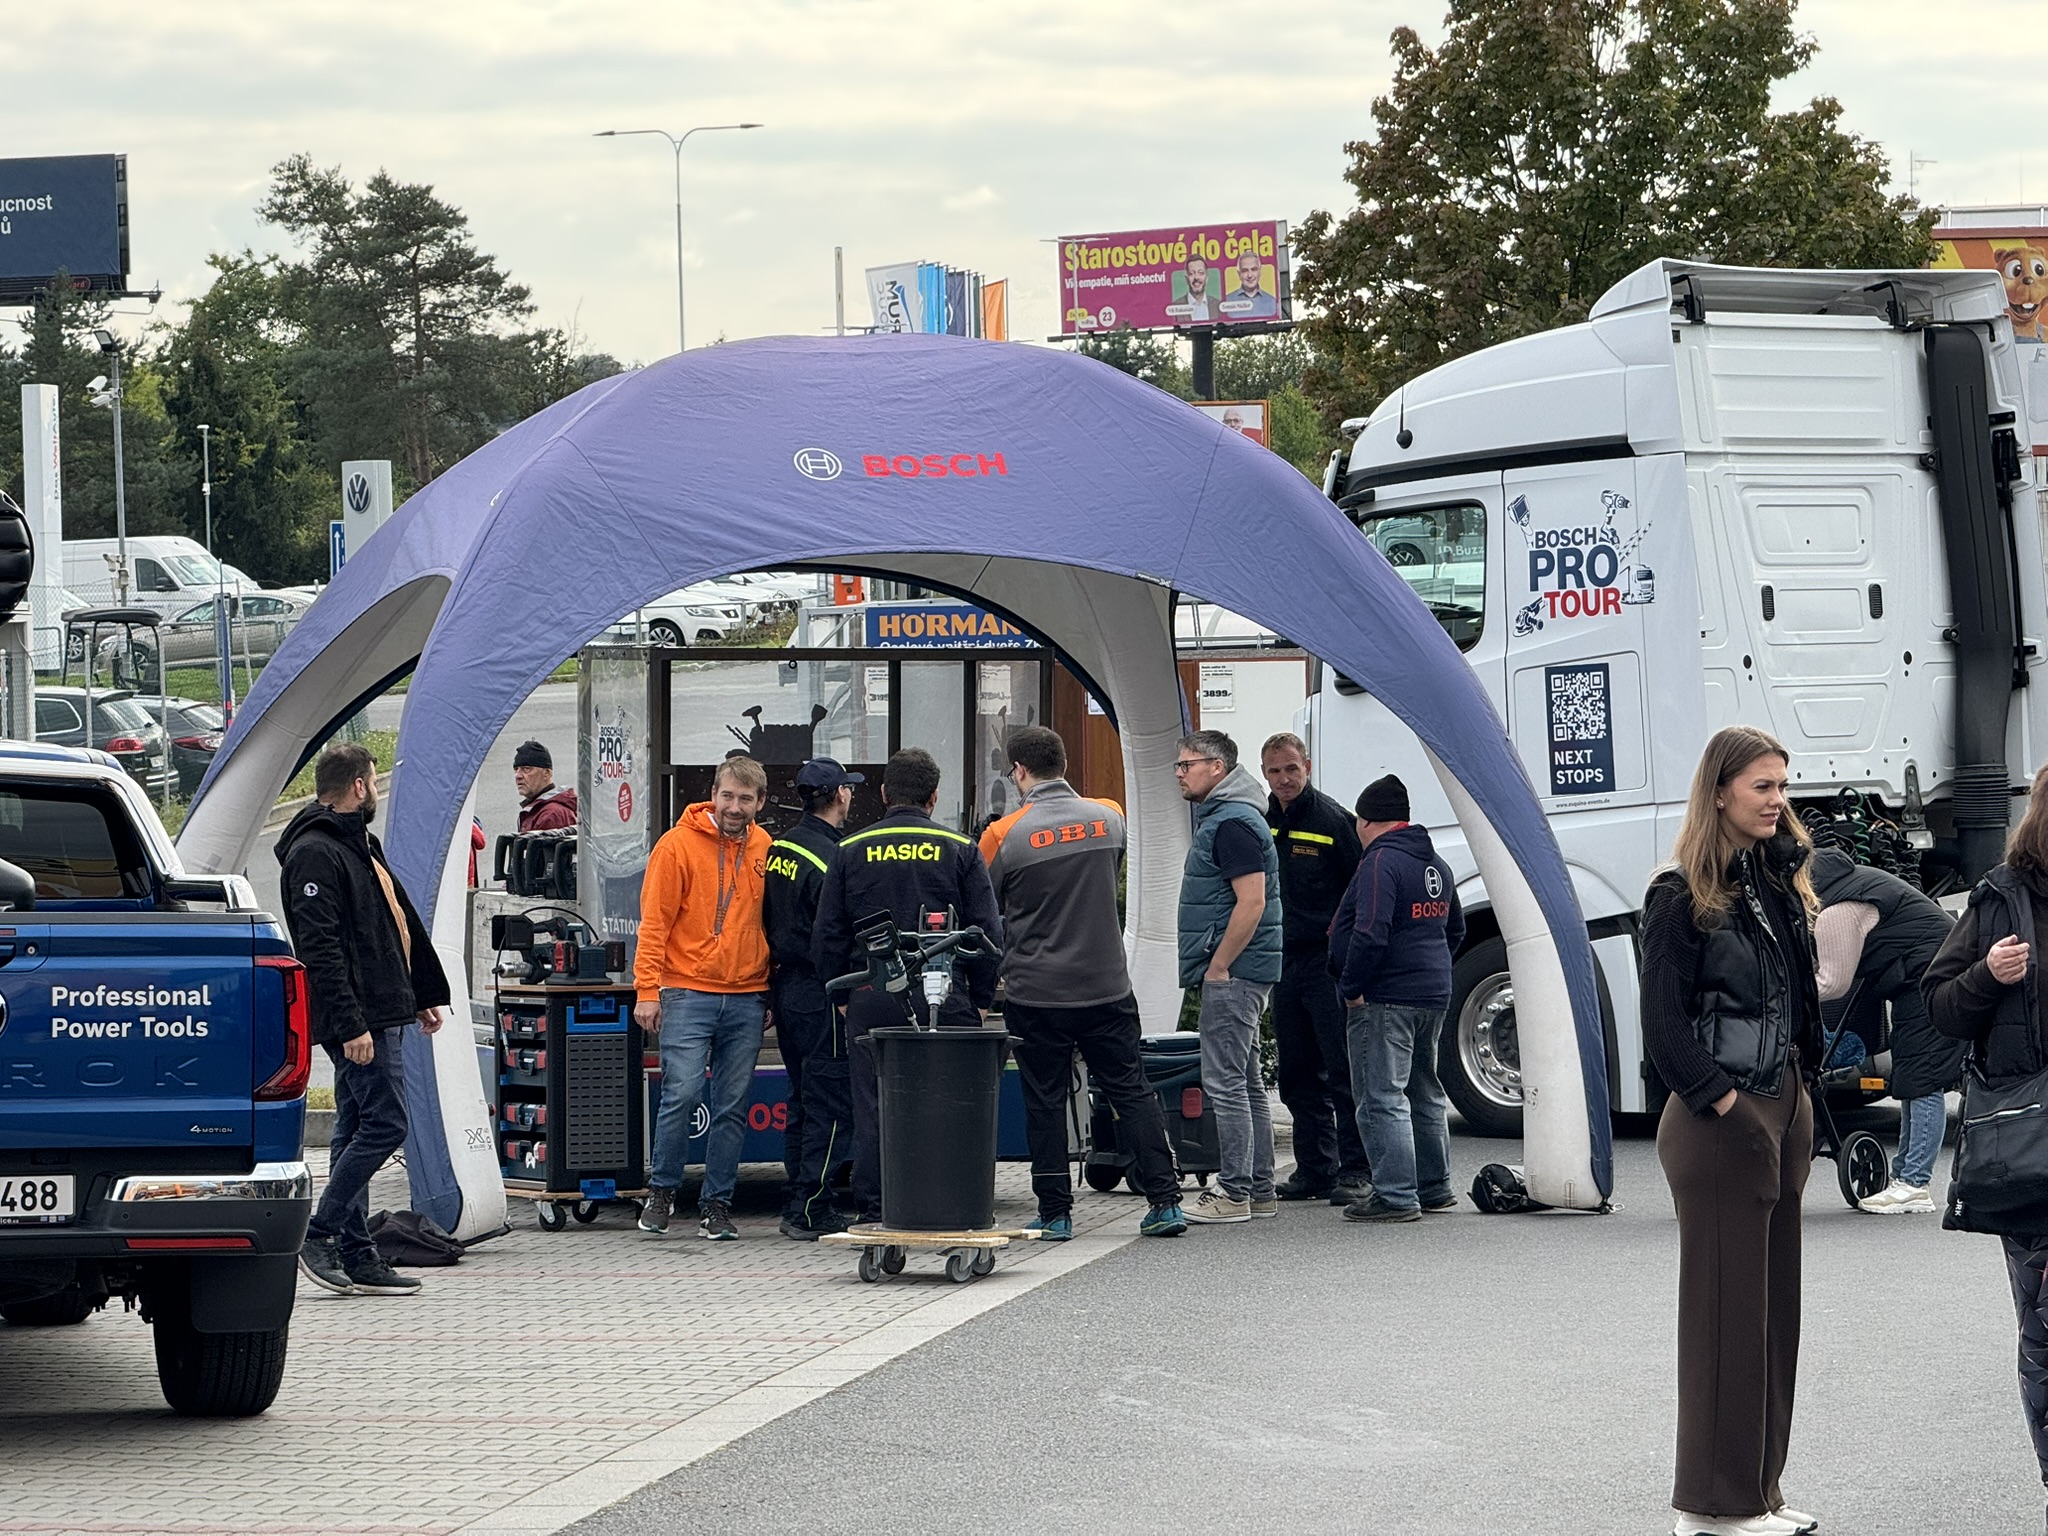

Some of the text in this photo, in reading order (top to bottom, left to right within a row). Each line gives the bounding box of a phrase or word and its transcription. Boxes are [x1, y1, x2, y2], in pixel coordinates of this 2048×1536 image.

[1065, 229, 1273, 271] Starostové do čela
[1130, 270, 1166, 284] sobectví
[1102, 311, 1113, 322] 23
[861, 451, 1009, 478] BOSCH
[1535, 527, 1597, 549] BOSCH
[1529, 544, 1619, 591] PRO
[1544, 587, 1622, 619] TOUR
[599, 737, 622, 762] PRO
[1554, 750, 1593, 766] NEXT
[603, 762, 623, 778] TOUR
[1556, 768, 1604, 784] STOPS
[1029, 820, 1108, 849] OBI
[867, 842, 941, 862] HASIČI
[1412, 902, 1449, 918] BOSCH
[52, 985, 211, 1006] Professional
[52, 1015, 208, 1038] Power Tools
[0, 1180, 58, 1212] 488
